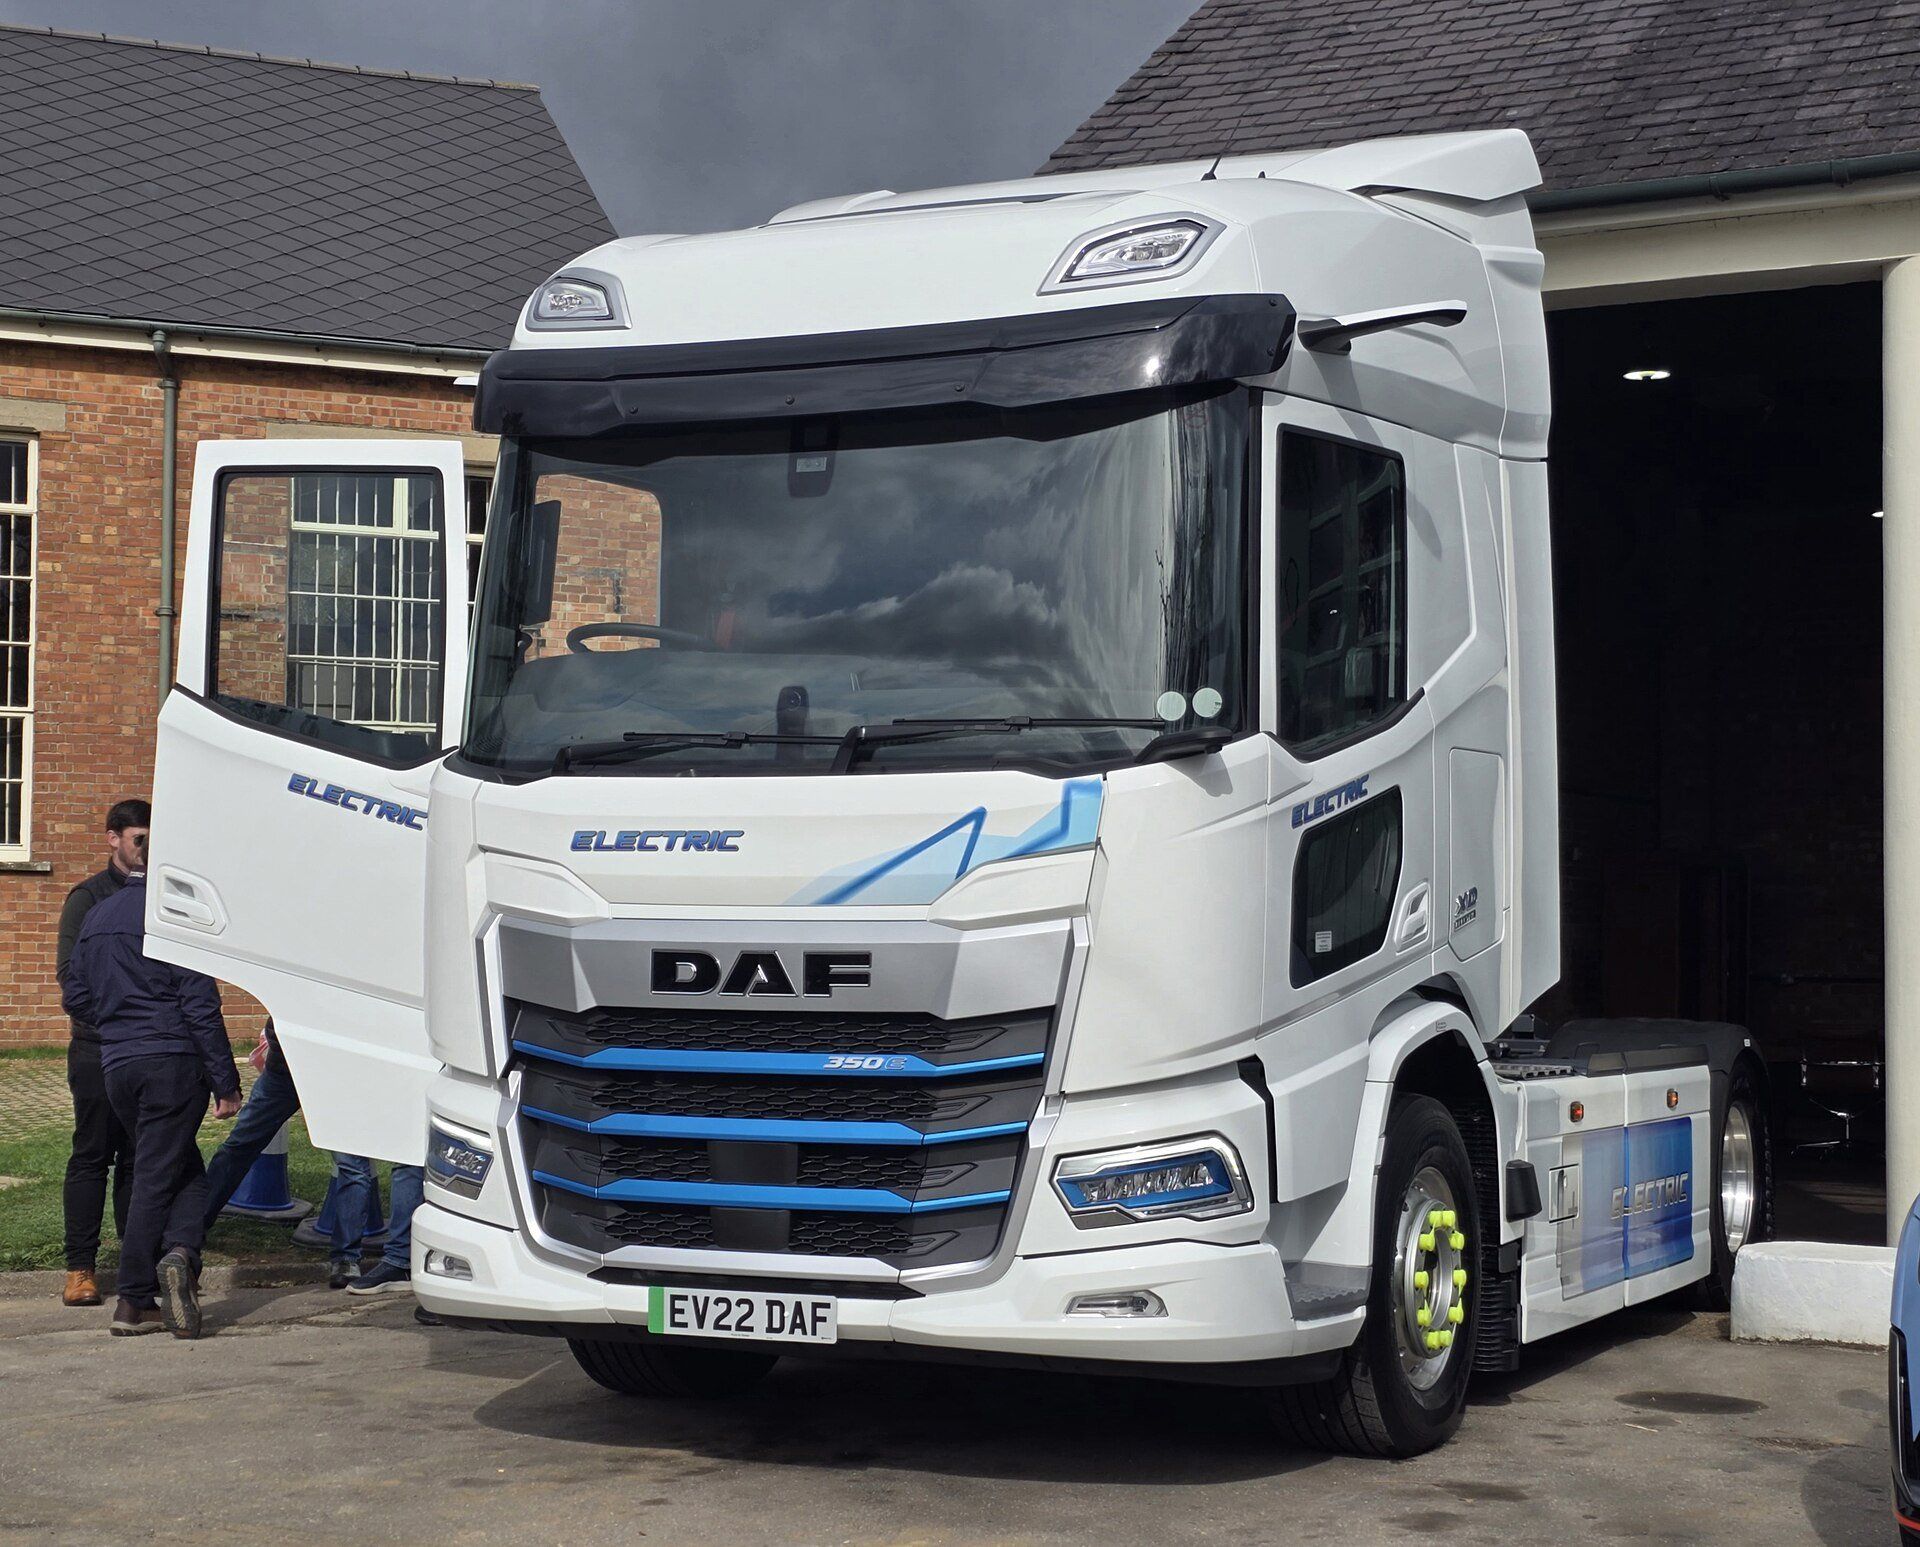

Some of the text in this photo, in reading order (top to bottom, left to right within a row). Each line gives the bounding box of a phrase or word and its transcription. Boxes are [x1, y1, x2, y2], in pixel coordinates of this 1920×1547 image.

[287, 773, 428, 831] ELECTRIC
[1291, 773, 1370, 830] ELECTRIC
[570, 830, 745, 852] ELECTRIC
[650, 949, 872, 998] DAF
[1609, 1172, 1690, 1221] ELECTRIC
[669, 1293, 831, 1337] EV22 DAF
